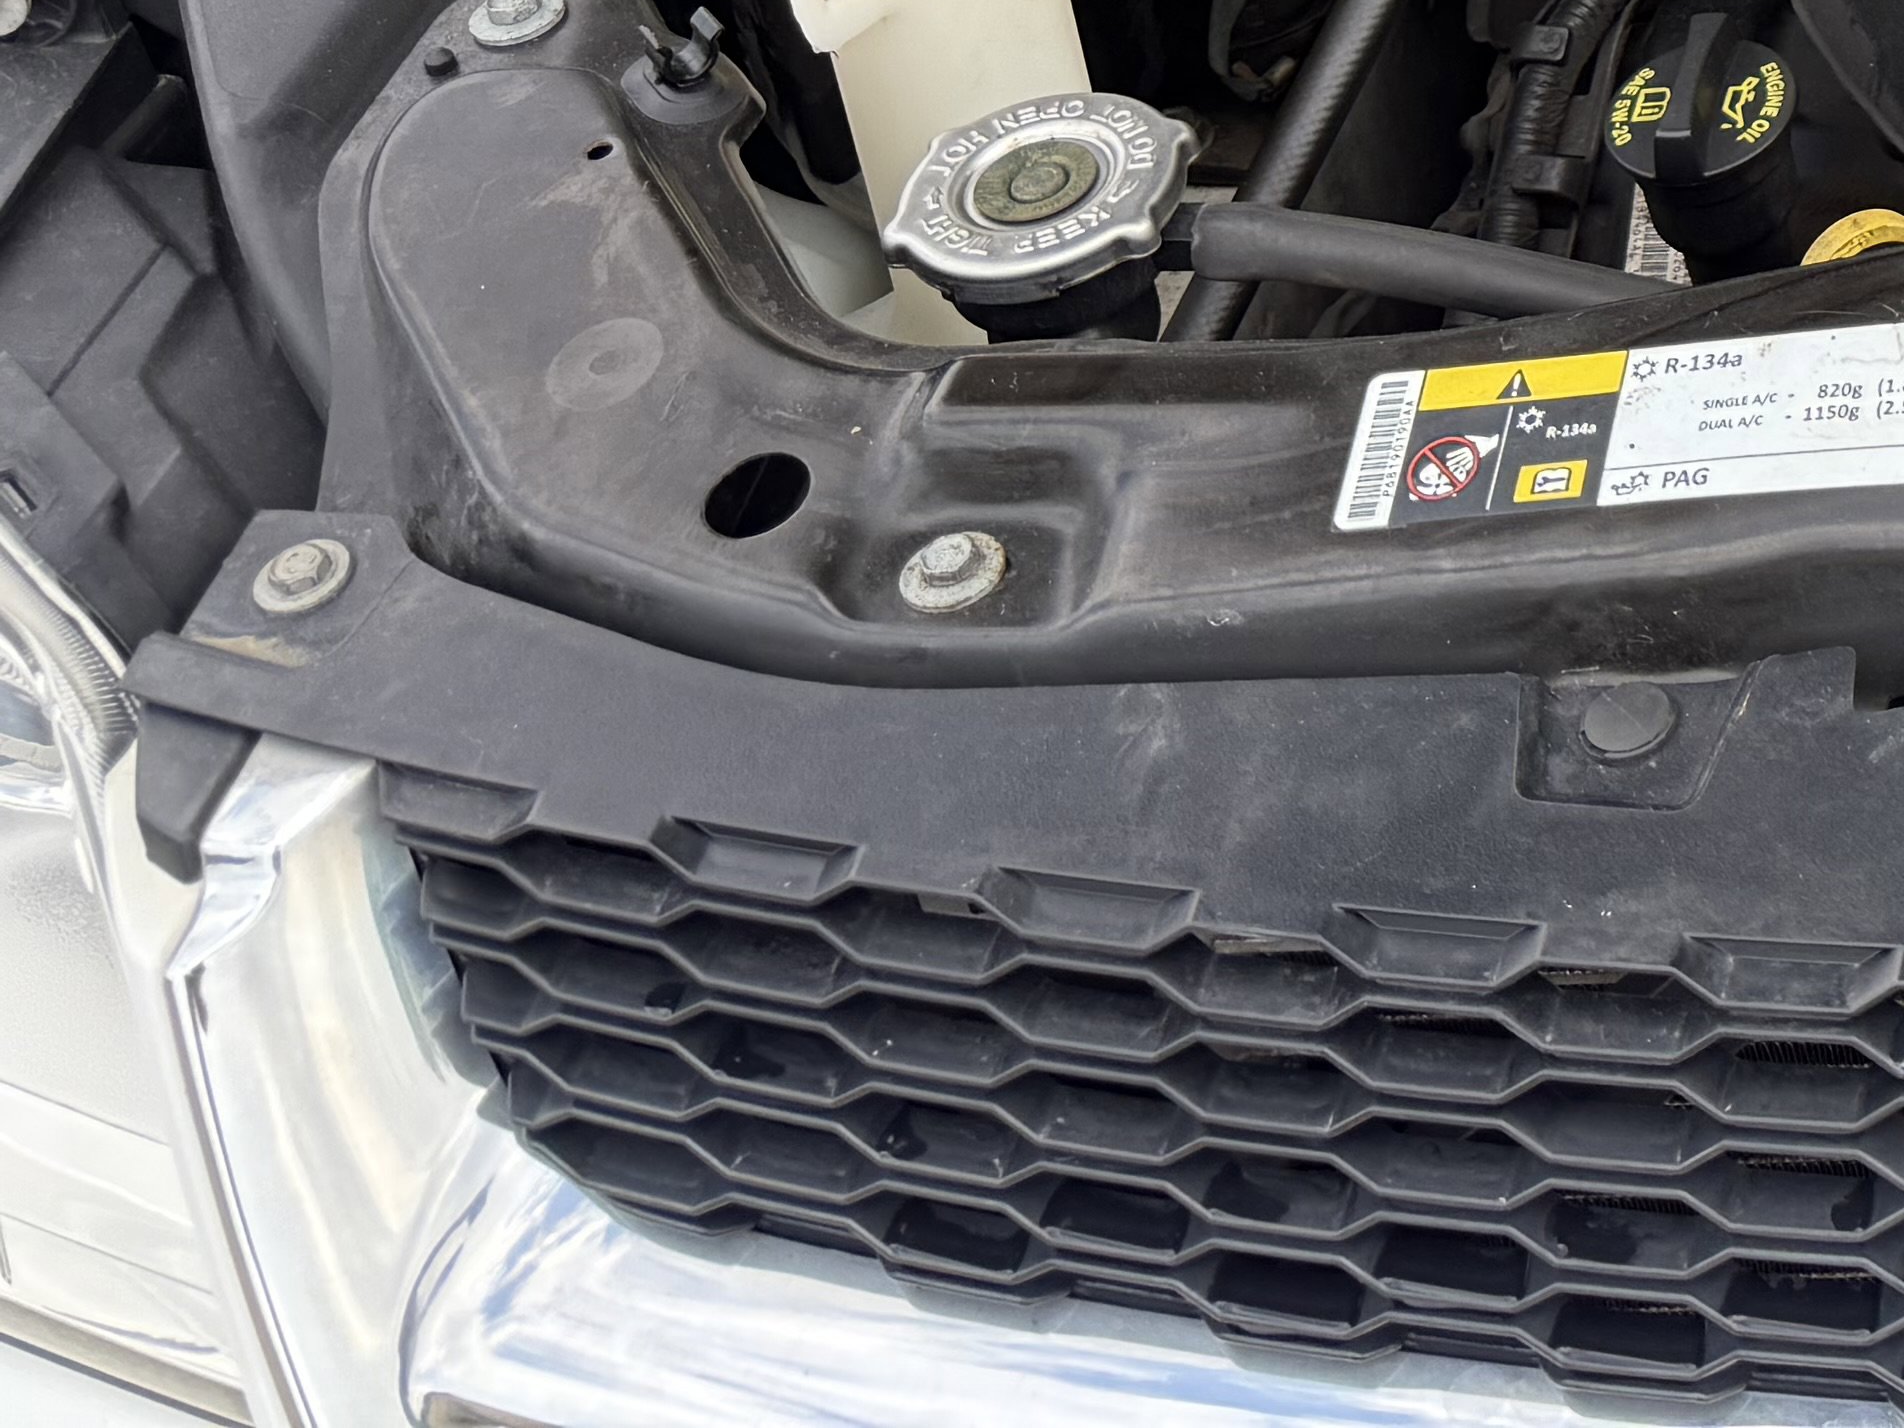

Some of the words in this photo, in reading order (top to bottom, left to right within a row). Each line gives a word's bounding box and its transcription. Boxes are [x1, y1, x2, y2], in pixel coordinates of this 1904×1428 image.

[1621, 67, 1655, 97] SAE
[1759, 61, 1785, 118] ENGINE
[1611, 99, 1633, 147] 5W-20
[1735, 119, 1771, 144] OIL
[1664, 352, 1743, 374] R-134a
[1703, 395, 1749, 410] SINGLE
[1752, 391, 1778, 405] A/C
[1817, 382, 1863, 400] 820g
[1546, 423, 1597, 439] R-134a
[1699, 417, 1733, 431] DUAL
[1737, 414, 1764, 428] A/C
[1802, 403, 1860, 421] 1150g
[1661, 467, 1710, 488] PAG
